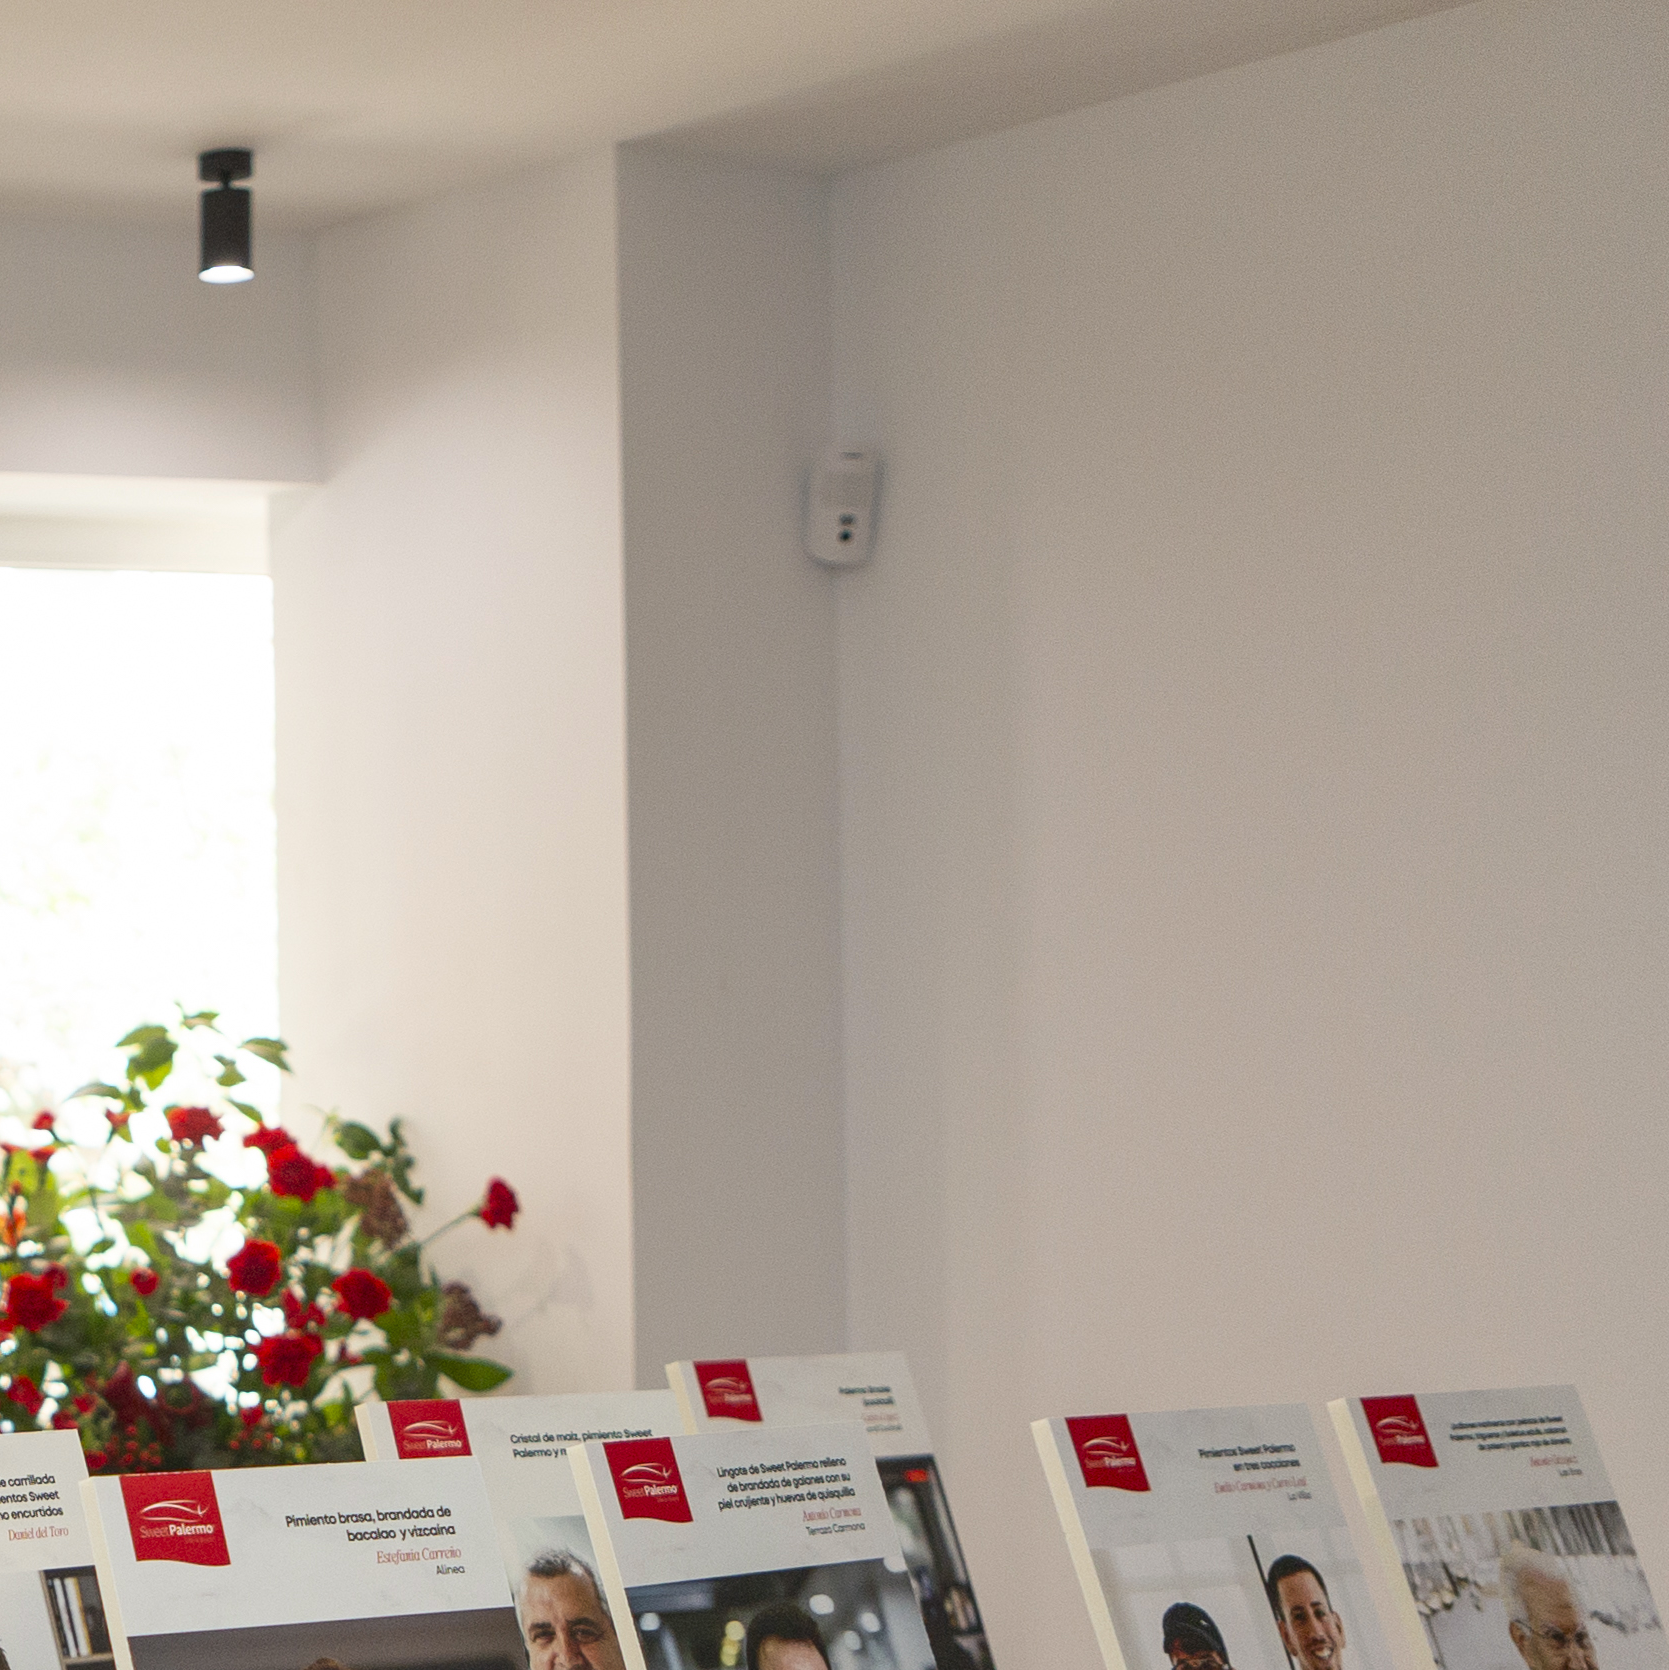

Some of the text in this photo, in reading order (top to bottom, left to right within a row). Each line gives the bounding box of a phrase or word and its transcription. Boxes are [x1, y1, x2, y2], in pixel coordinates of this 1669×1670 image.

[510, 1432, 541, 1445] Cristal
[542, 1432, 555, 1443] de
[582, 1429, 623, 1443] pimiento
[623, 1428, 653, 1439] Sweet
[513, 1447, 553, 1459] Palermo
[716, 1456, 847, 1479] Lingote de Sweet Palermo relleno
[8, 1473, 56, 1487] carrillada
[727, 1472, 851, 1493] de brandada de con su
[29, 1490, 60, 1501] Sweet
[718, 1486, 856, 1512] piel crujiente y huevas de quisquilla
[11, 1506, 64, 1520] encurtidos
[285, 1505, 452, 1528] Pimiento brasa, brandada de
[8, 1528, 35, 1542] Daniel
[36, 1527, 48, 1539] del
[347, 1527, 397, 1542] bacalao
[399, 1528, 407, 1541] y
